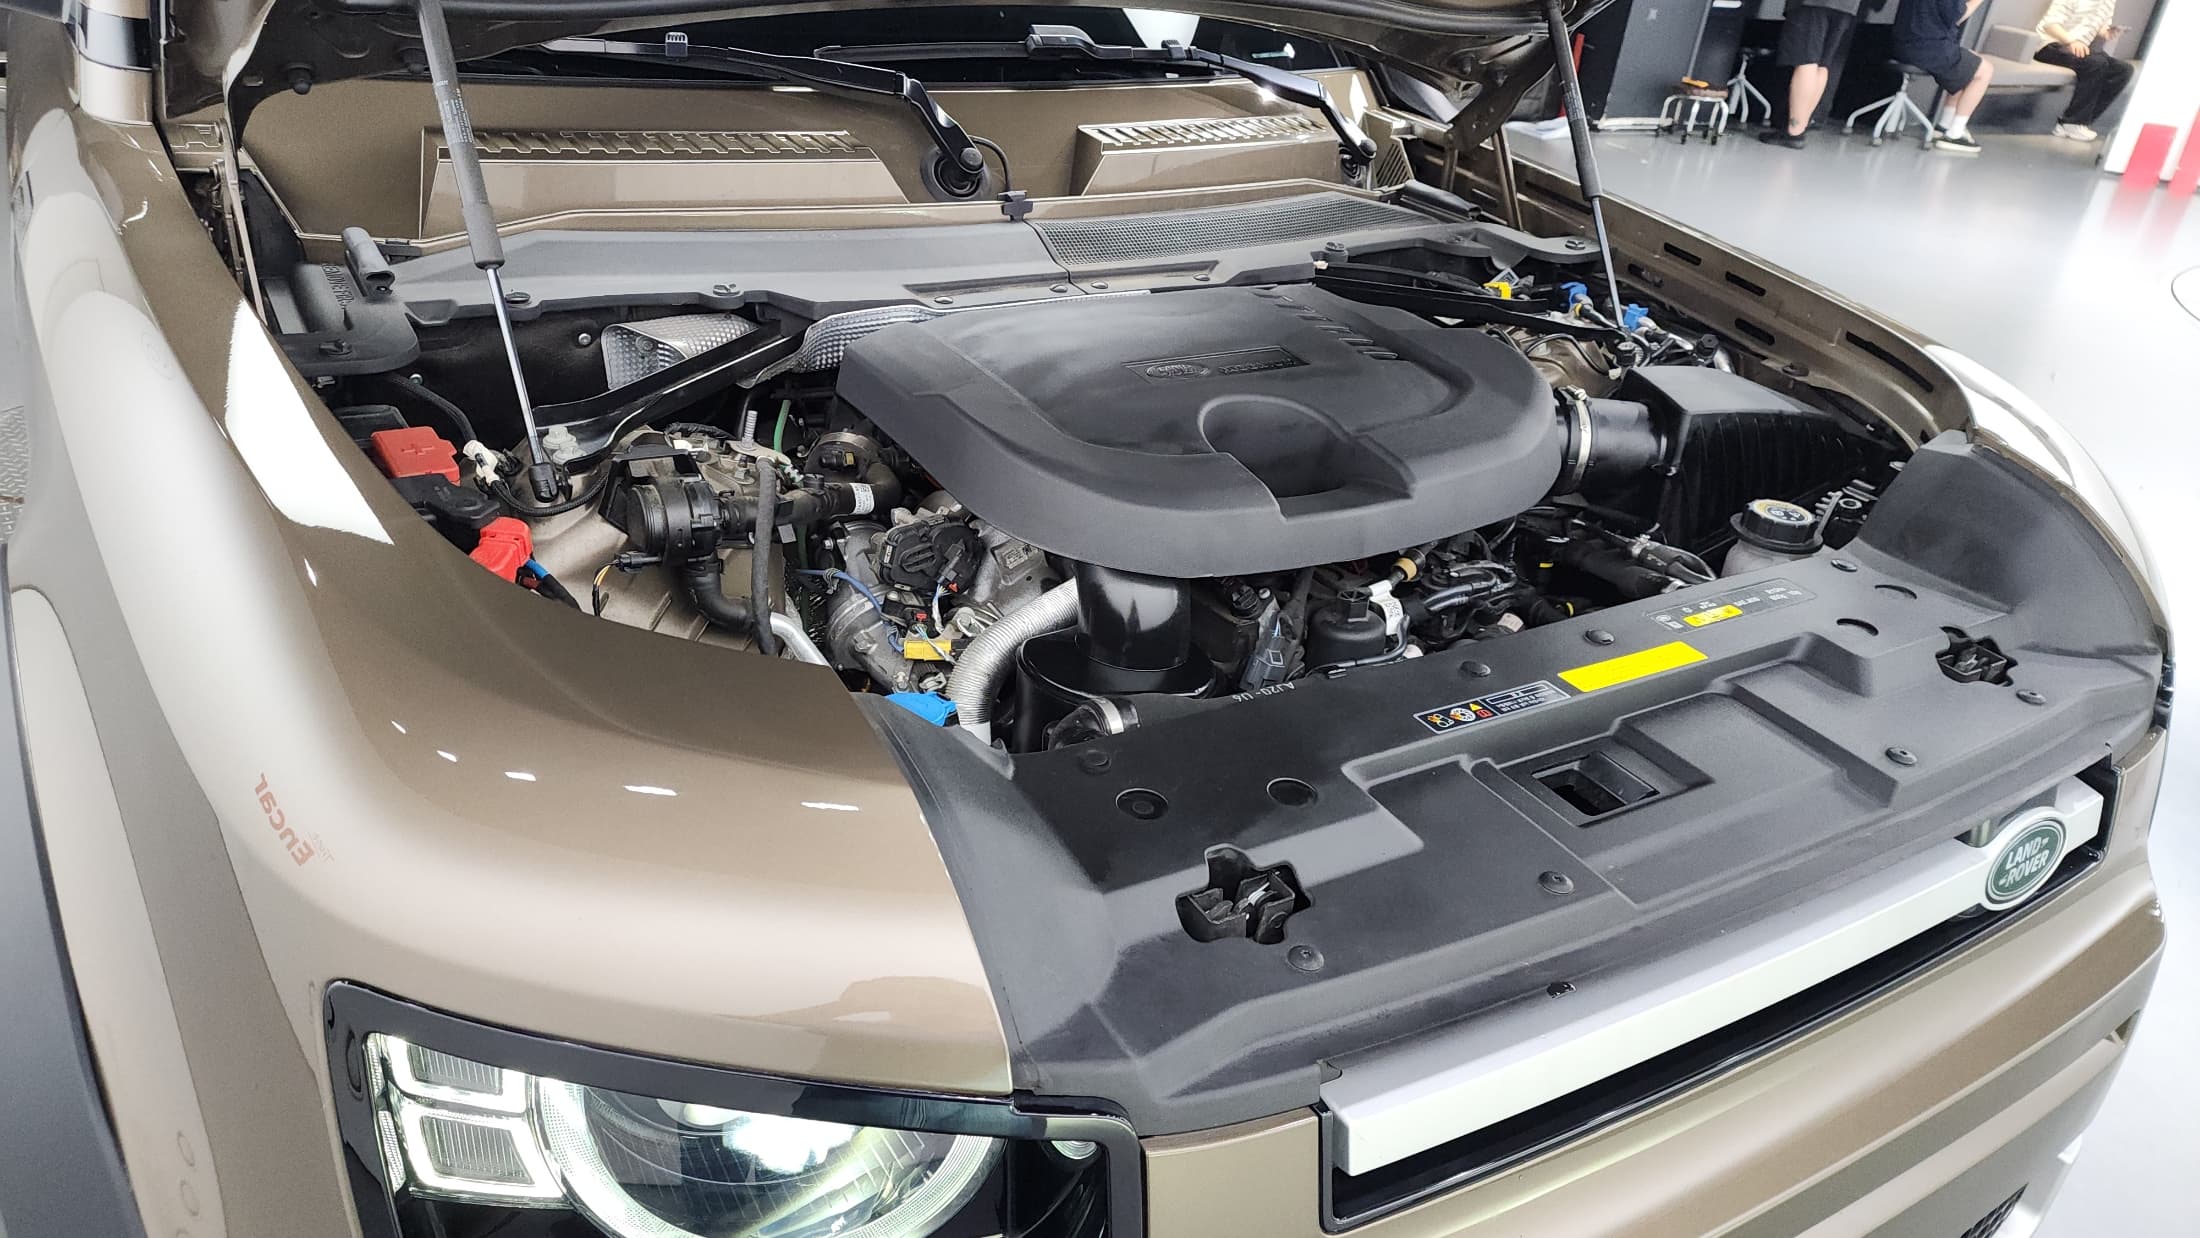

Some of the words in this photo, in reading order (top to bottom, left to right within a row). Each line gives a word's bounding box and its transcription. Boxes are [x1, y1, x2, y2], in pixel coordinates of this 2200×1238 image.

[1260, 681, 1295, 696] AJ20
[2003, 849, 2050, 888] ROVER
[2005, 836, 2042, 870] LAND
